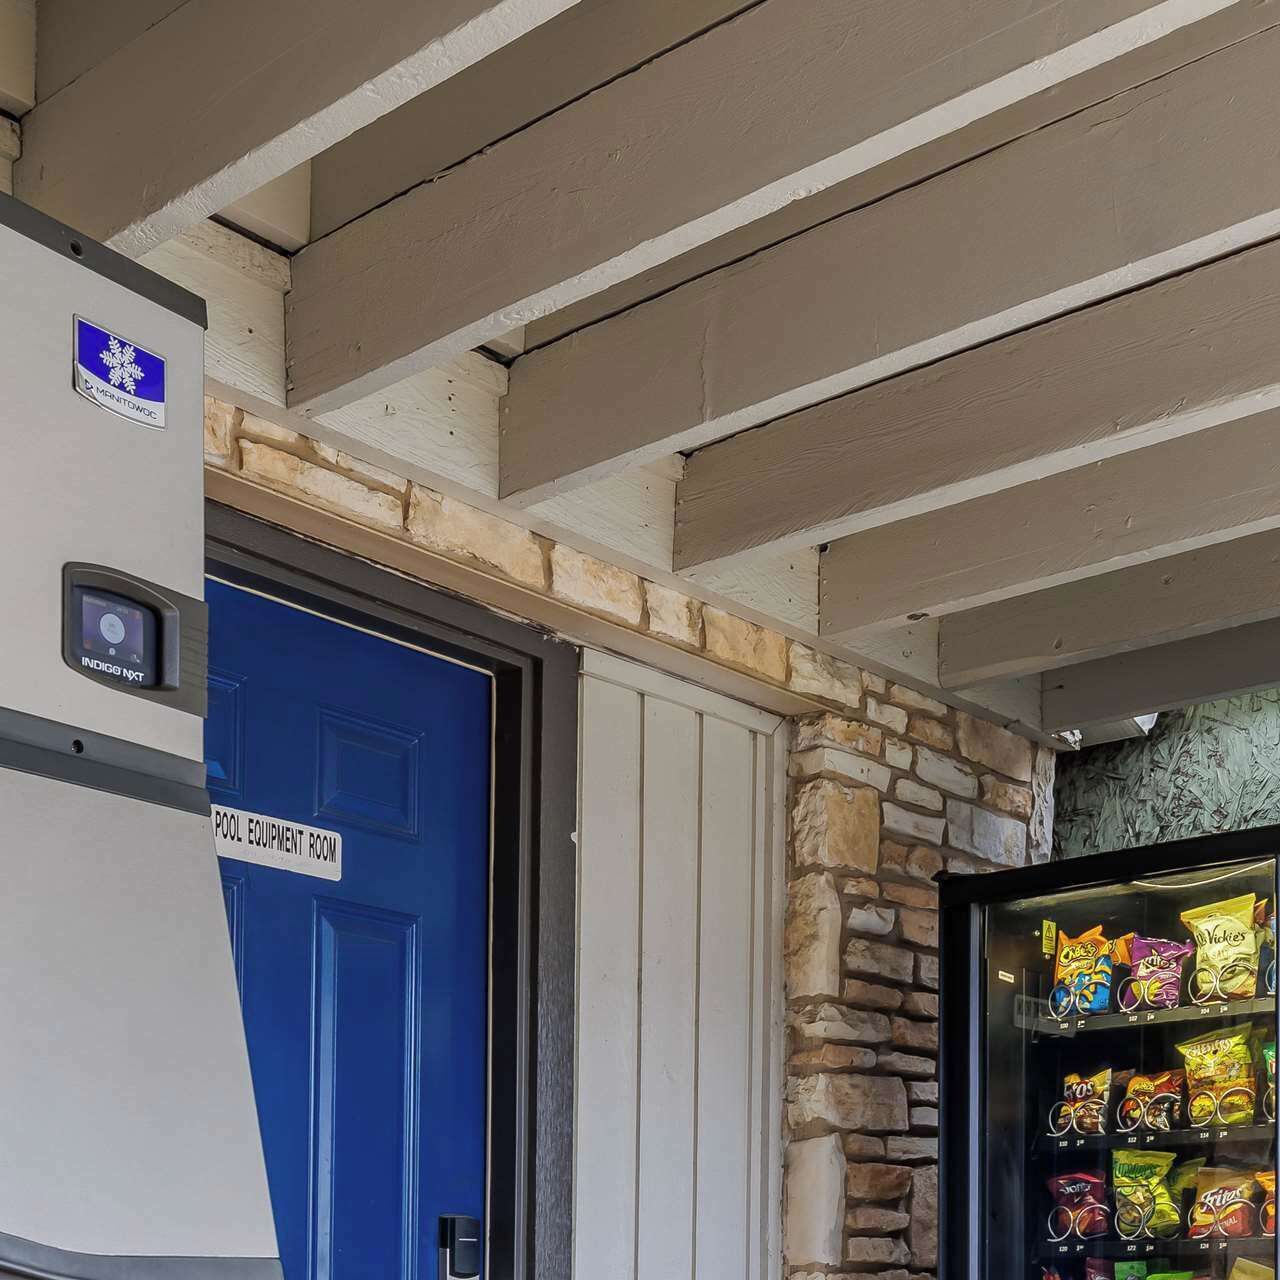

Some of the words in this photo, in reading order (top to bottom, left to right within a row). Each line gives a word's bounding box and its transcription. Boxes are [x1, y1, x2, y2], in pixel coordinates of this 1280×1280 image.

[96, 386, 158, 420] MANITOWOC
[81, 656, 121, 676] INDIGO
[122, 667, 145, 682] NXT
[215, 810, 242, 843] POOL
[247, 818, 304, 856] EQUIPMENT
[308, 832, 337, 864] ROOM
[1205, 924, 1253, 947] Vickie's
